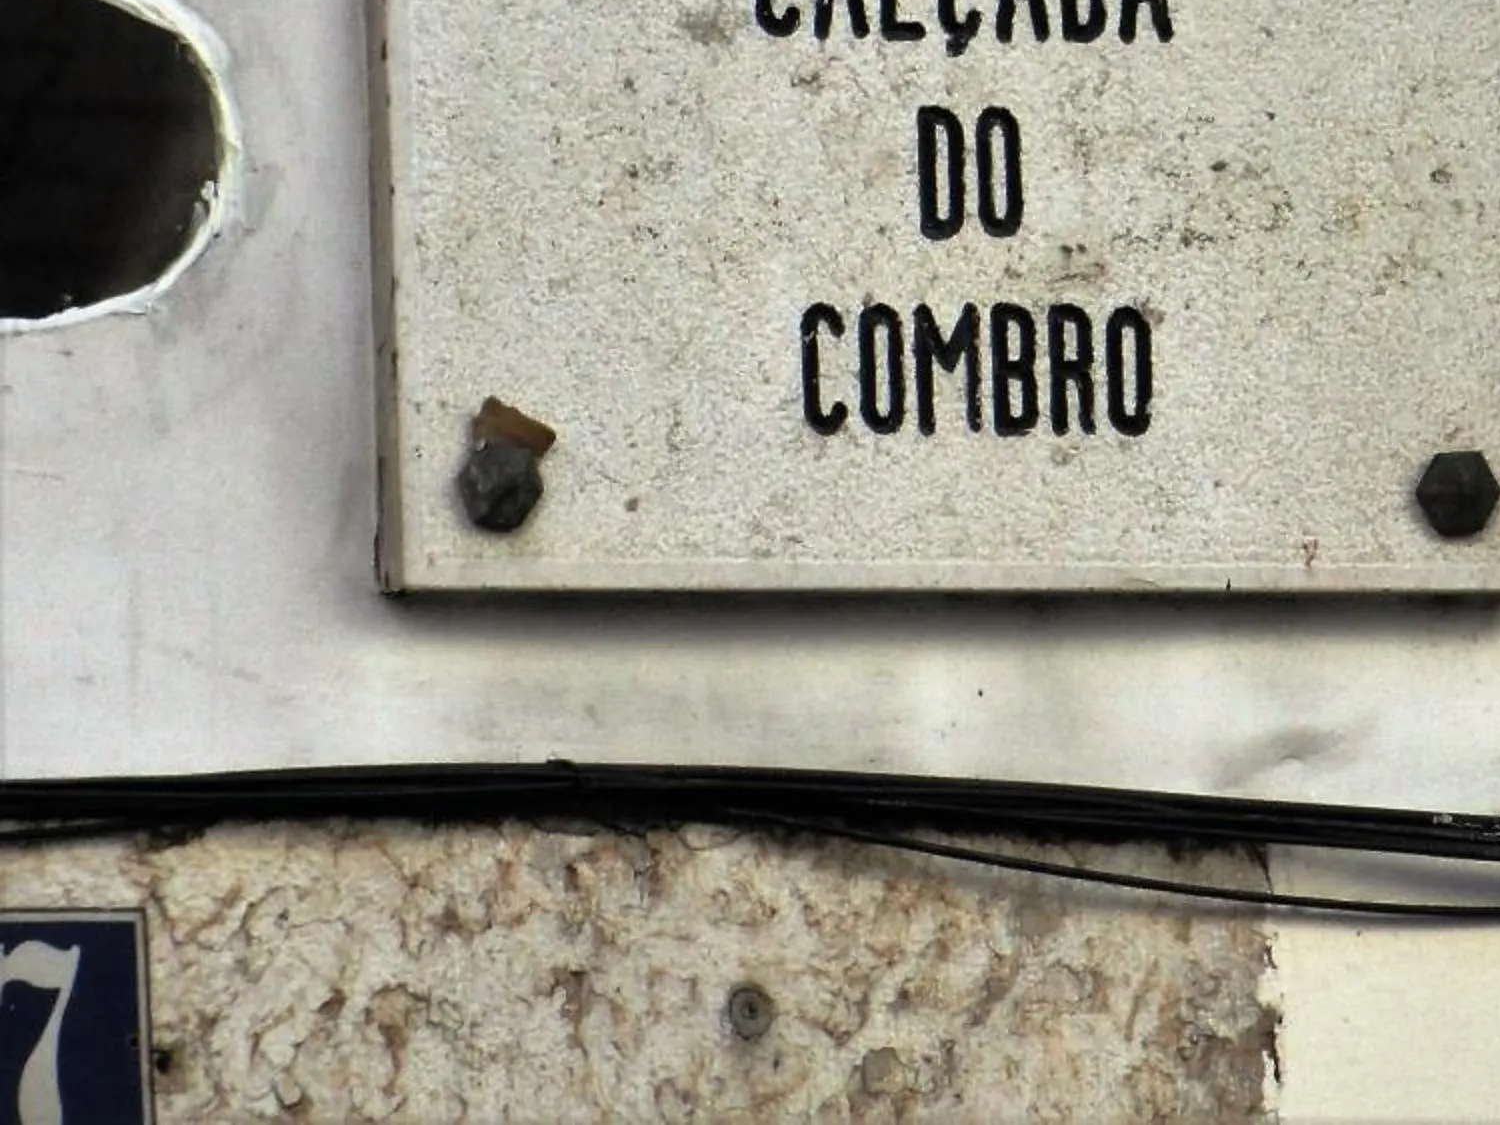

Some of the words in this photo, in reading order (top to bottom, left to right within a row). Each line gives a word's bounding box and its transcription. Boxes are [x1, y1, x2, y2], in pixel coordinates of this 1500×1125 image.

[916, 105, 1026, 241] DO
[798, 301, 1154, 438] COMBRO
[0, 939, 81, 1125] 7
